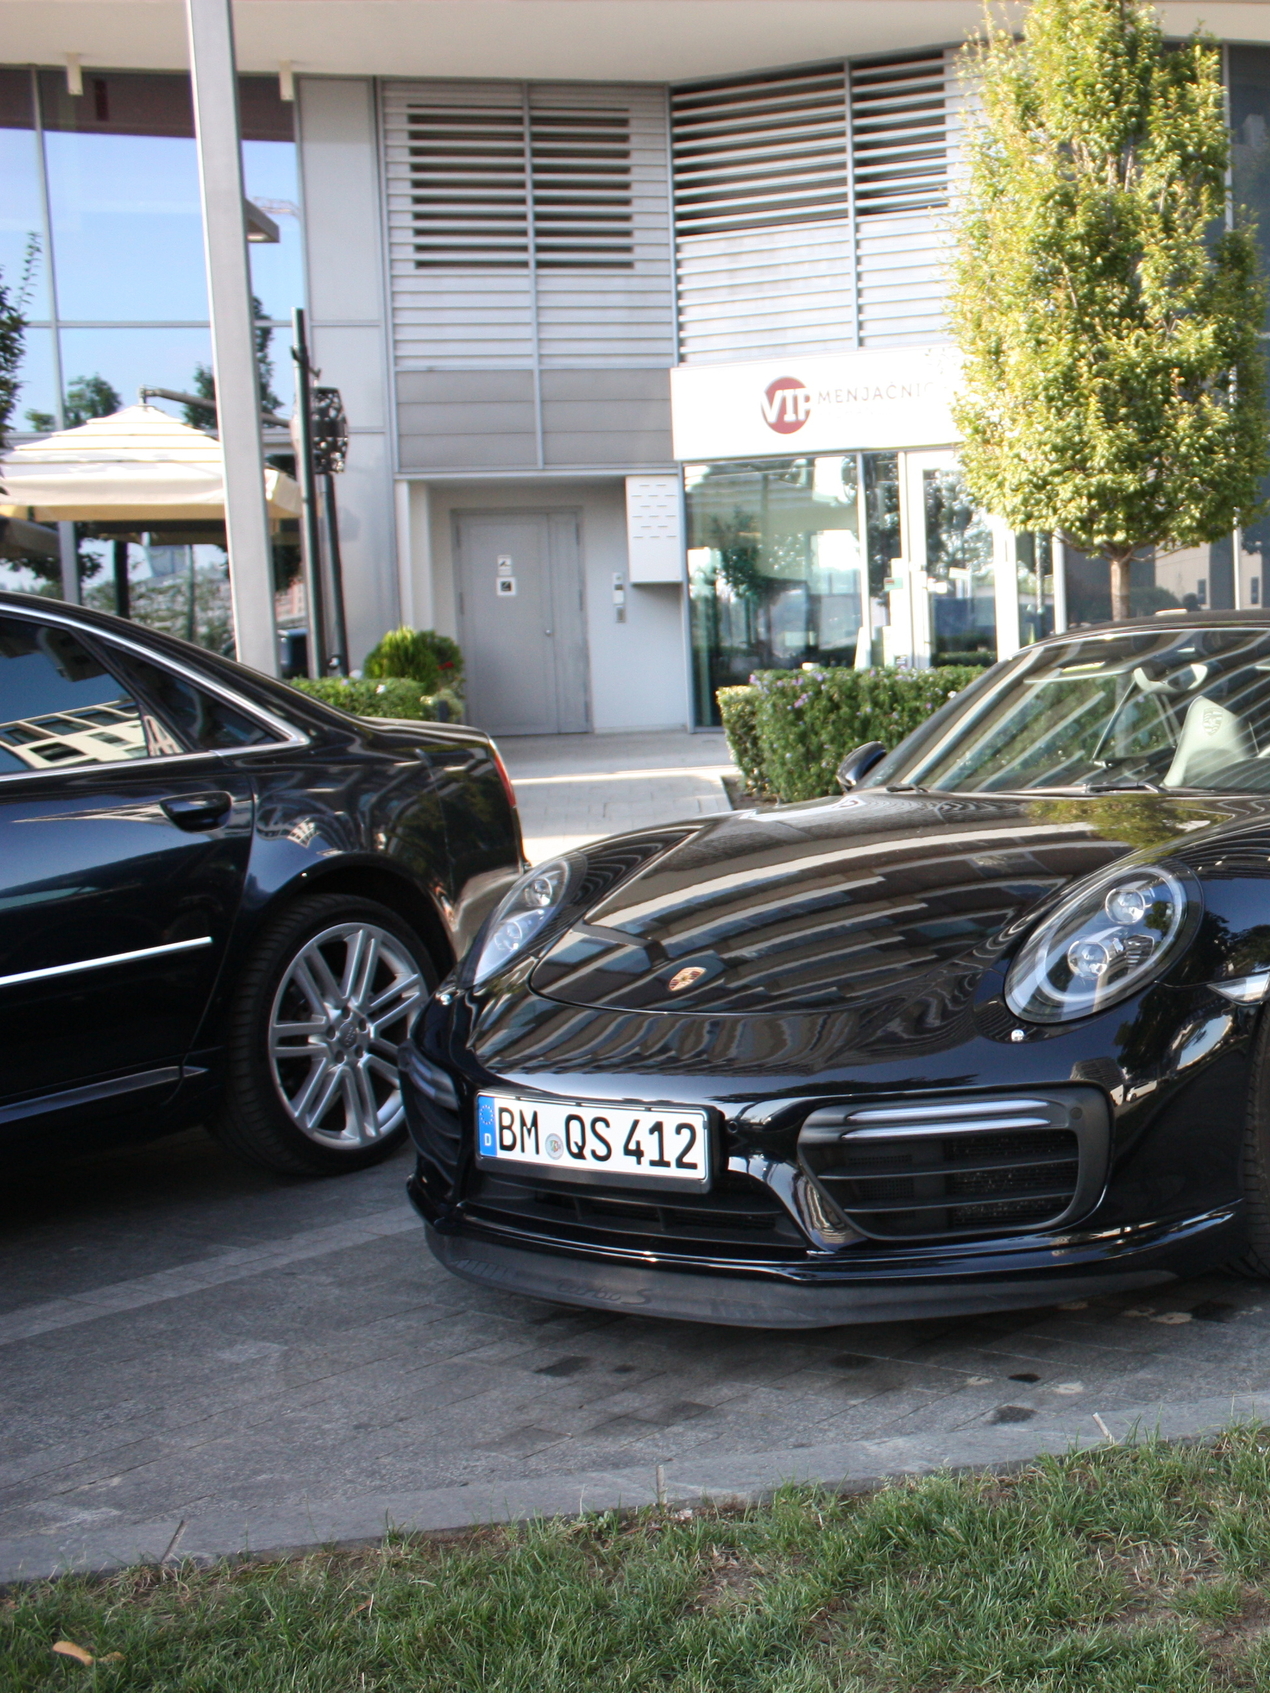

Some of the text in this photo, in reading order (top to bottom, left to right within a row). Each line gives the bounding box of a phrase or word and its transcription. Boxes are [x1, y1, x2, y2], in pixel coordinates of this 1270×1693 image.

[761, 387, 813, 424] VIP
[484, 1132, 493, 1147] D
[498, 1106, 698, 1170] BM QS 412
